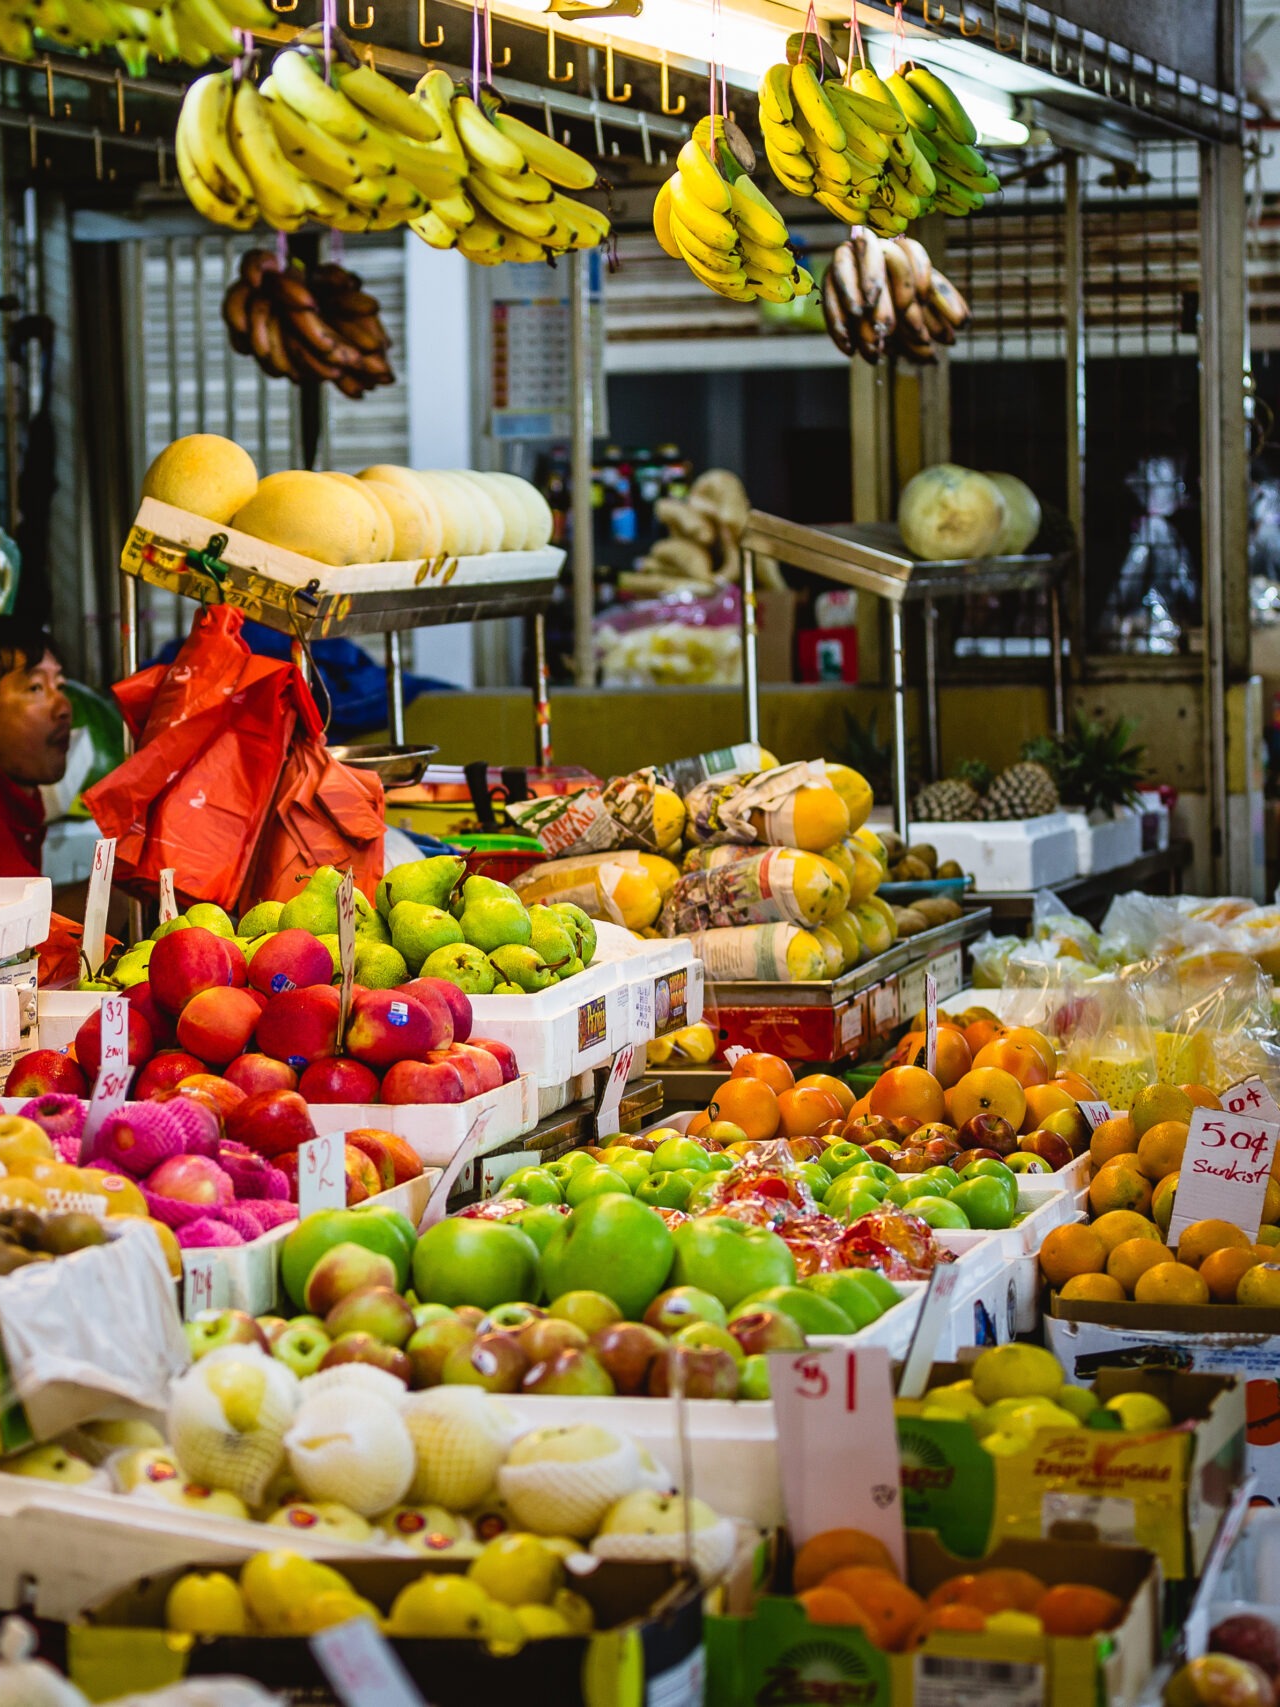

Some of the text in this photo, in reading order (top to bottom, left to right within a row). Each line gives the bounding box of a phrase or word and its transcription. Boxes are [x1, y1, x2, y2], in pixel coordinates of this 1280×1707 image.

[307, 1138, 335, 1192] $2
[1201, 1122, 1269, 1163] 50¢
[1193, 1159, 1271, 1184] Sunkist
[793, 1351, 858, 1412] $1
